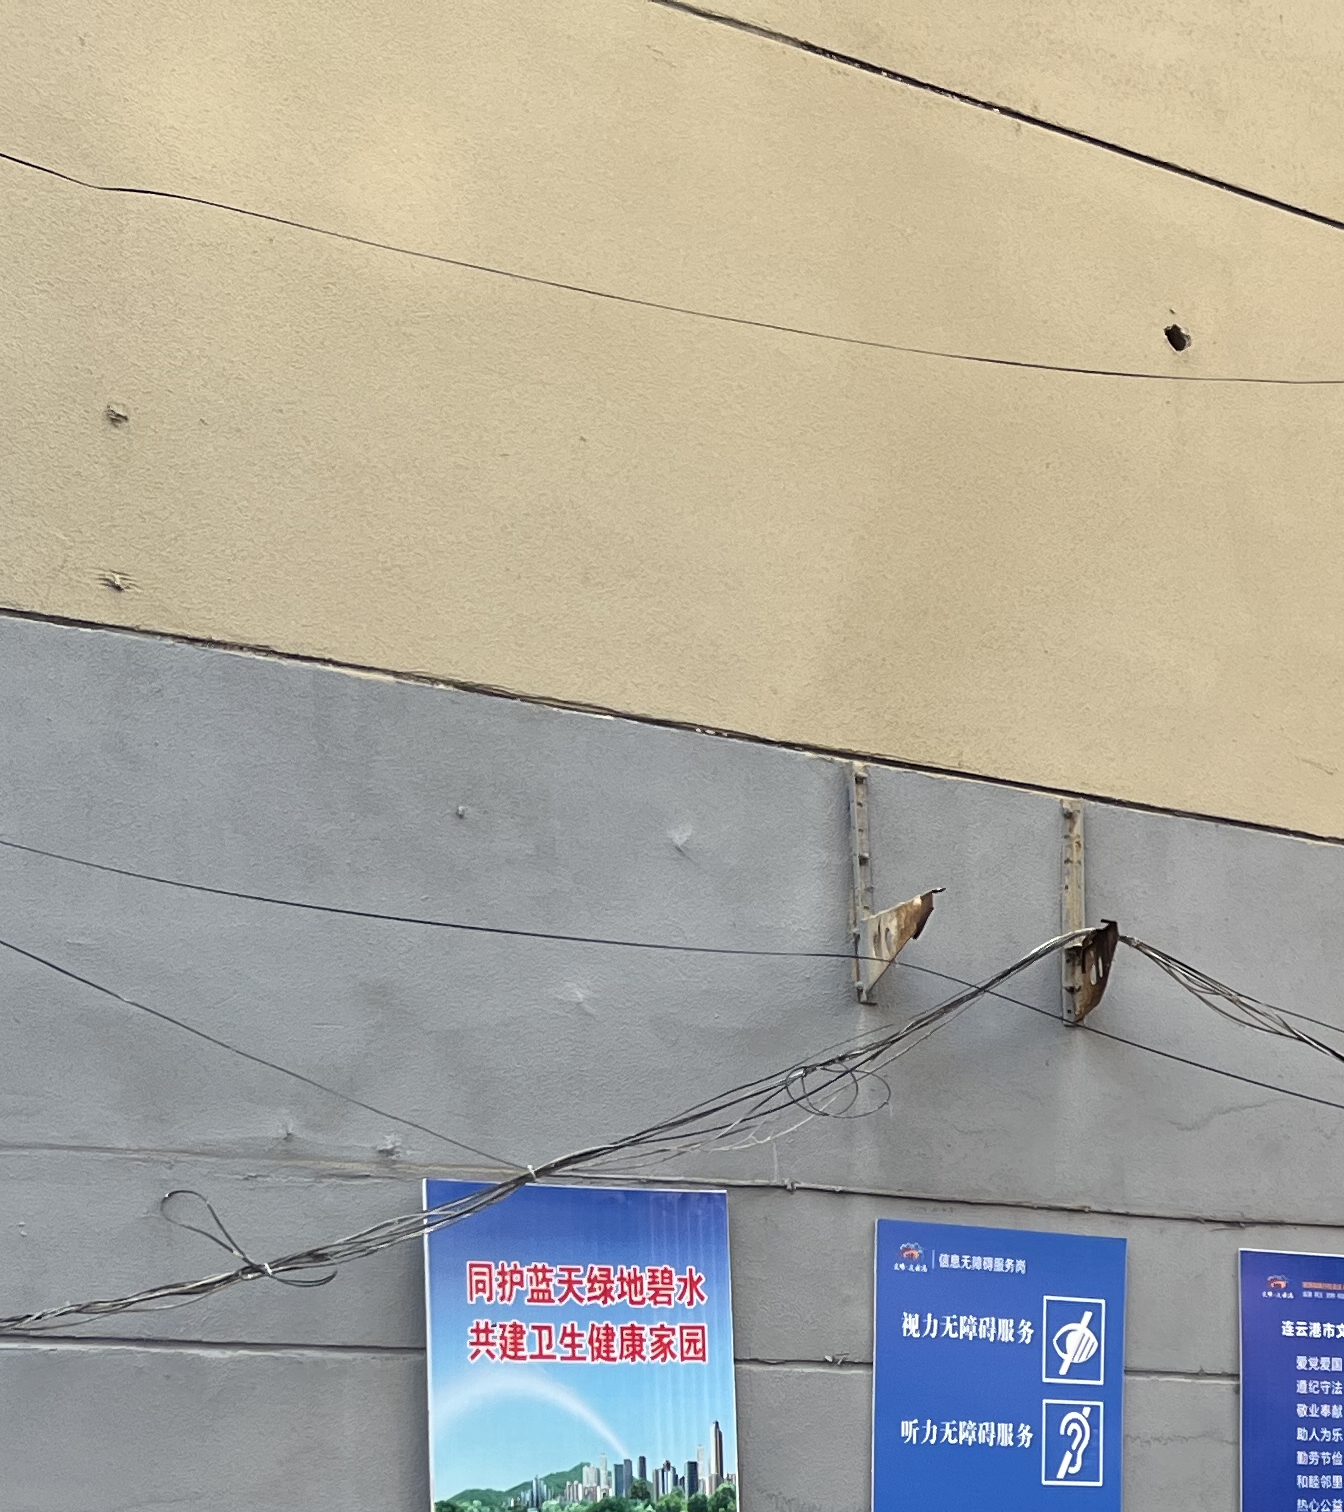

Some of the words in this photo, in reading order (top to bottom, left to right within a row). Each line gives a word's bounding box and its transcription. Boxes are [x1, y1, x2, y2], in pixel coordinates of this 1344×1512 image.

[939, 1253, 1027, 1275] 信息无障碍服务岗
[467, 1262, 707, 1307] 同护蓝天绿地碧水
[902, 1311, 1035, 1345] 视力无障碍服务
[468, 1320, 708, 1364] 共建卫生健康家园
[1296, 1356, 1343, 1372] 爱党爱国
[1296, 1380, 1343, 1395] 遵纪守法
[1296, 1404, 1343, 1418] 敬业奉献
[901, 1418, 1034, 1449] 听力无障碍服务
[1296, 1427, 1343, 1442] 助人为乐
[1296, 1451, 1343, 1466] 勤劳节俭
[1296, 1475, 1343, 1489] 和睦邻里
[1296, 1499, 1343, 1512] 热心公益
